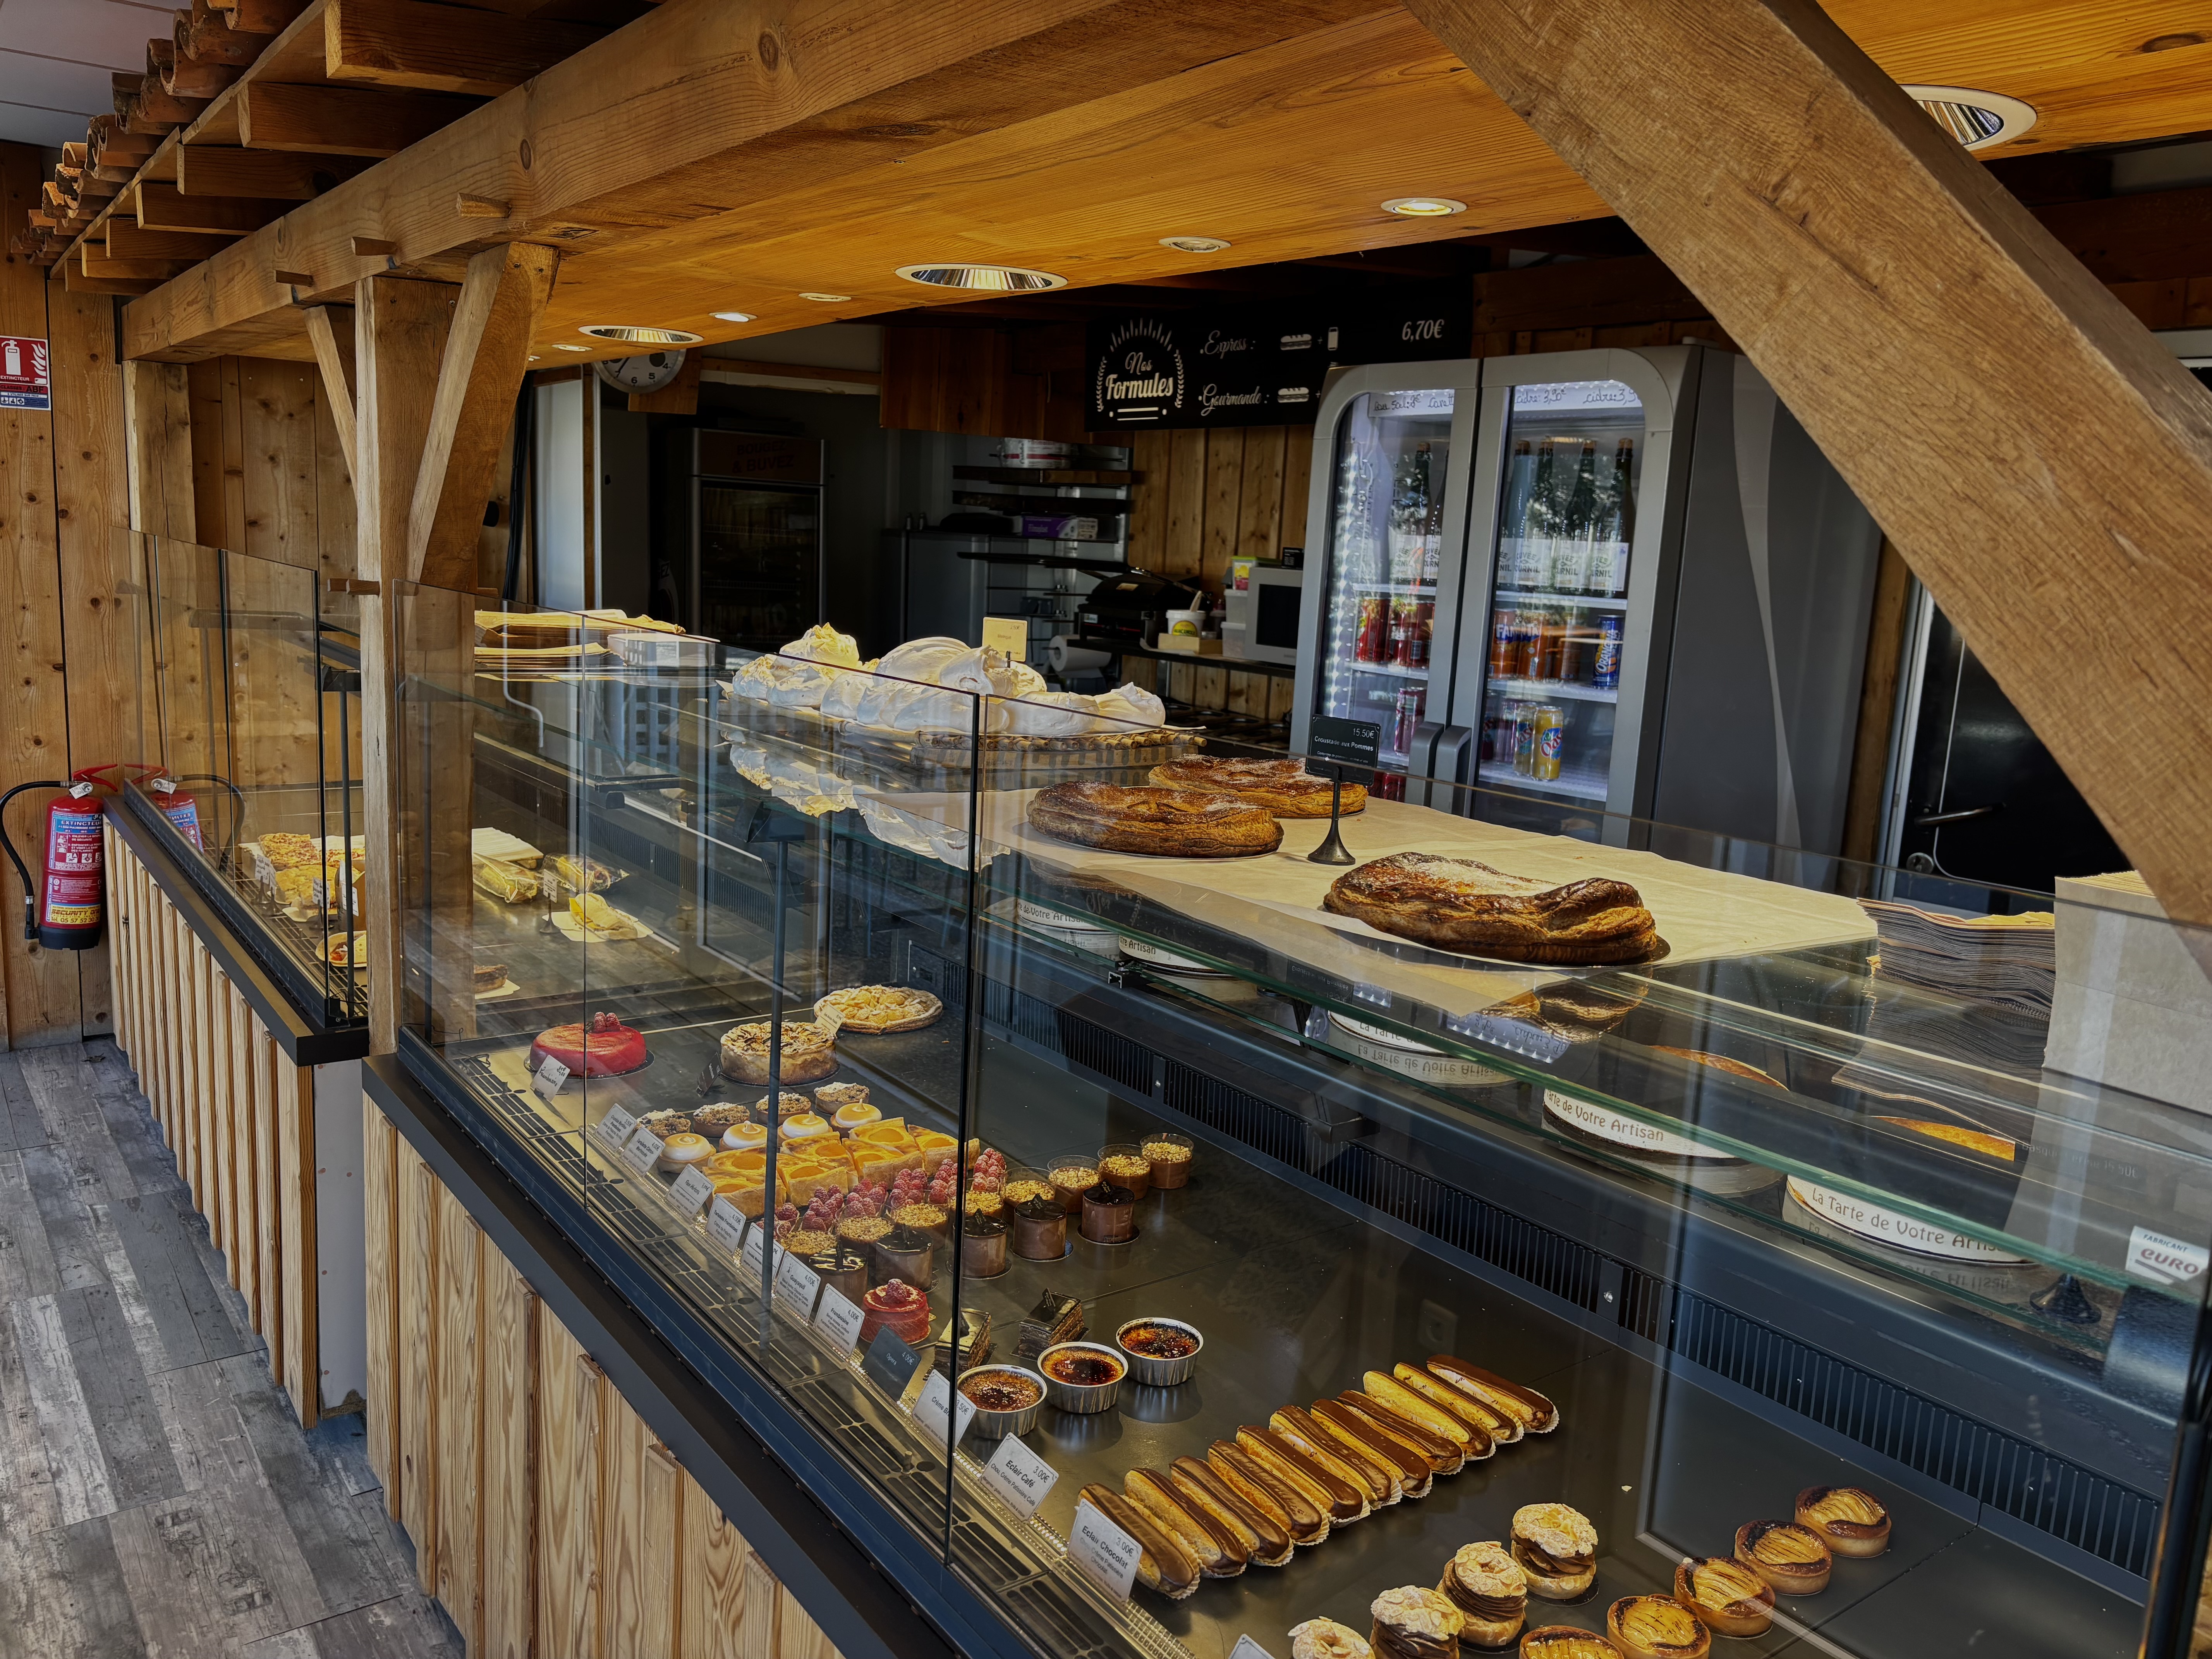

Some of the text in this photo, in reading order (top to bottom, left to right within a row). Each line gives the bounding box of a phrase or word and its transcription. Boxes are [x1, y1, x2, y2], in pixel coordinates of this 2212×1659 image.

[1401, 319, 1444, 342] 6,70€
[1204, 330, 1247, 359] Express
[1125, 352, 1153, 374] Nos
[1105, 373, 1174, 400] Formules
[1200, 383, 1262, 417] Gourmande
[737, 440, 786, 455] BOUGEZ
[747, 455, 794, 471] BUVEZ
[1353, 728, 1374, 738] 15.50€
[1315, 736, 1340, 745] Croustade
[1351, 742, 1374, 751] Pommes
[1030, 907, 1050, 919] Votre
[1129, 940, 1156, 955] Artisan
[1563, 1100, 1572, 1114] de
[1576, 1105, 1606, 1127] Votre
[1611, 1119, 1664, 1142] Artisan
[1812, 1188, 1824, 1205] La
[1828, 1195, 1864, 1222] Tarte
[1871, 1214, 1889, 1230] de
[1897, 1220, 1944, 1244] Votre
[2143, 1233, 2189, 1254] FABRICANT
[790, 1273, 805, 1291] Guayaquil
[804, 1273, 816, 1288] 4.00€
[830, 1307, 849, 1326] Framboisine
[847, 1308, 859, 1322] 4.00€
[886, 1353, 897, 1365] Opera
[902, 1351, 915, 1365] 4.00€
[931, 1395, 945, 1410] Crème
[1005, 1458, 1036, 1489] Eclair Café
[1032, 1465, 1051, 1484] 3.00€
[1000, 1471, 1013, 1485] Crème
[1025, 1495, 1036, 1507] Café
[1099, 1539, 1128, 1570] Chocolat
